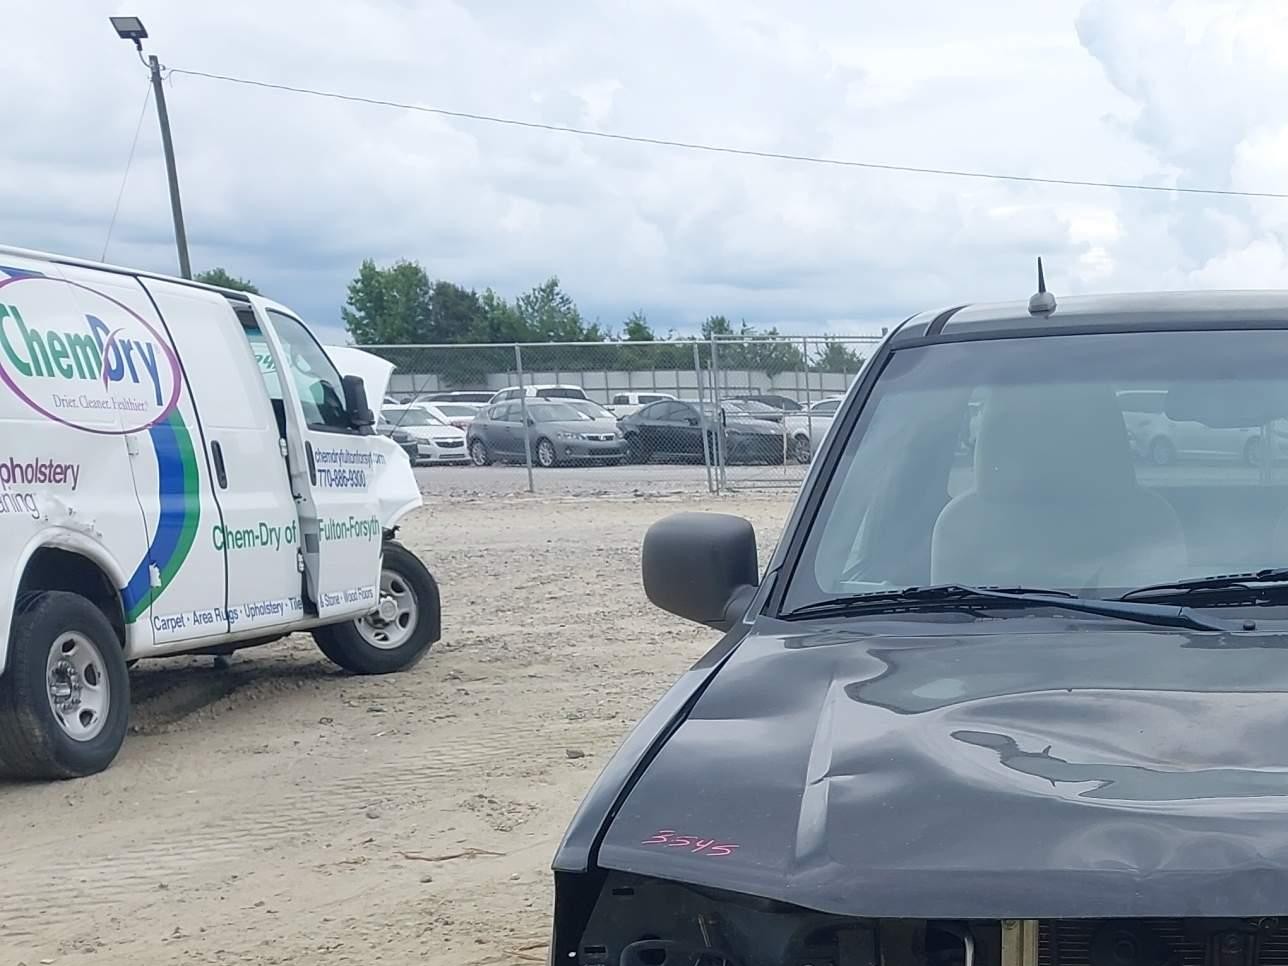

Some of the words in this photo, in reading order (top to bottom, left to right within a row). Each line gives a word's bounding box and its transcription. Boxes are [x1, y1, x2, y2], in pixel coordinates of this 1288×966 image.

[284, 520, 297, 543] of
[153, 613, 186, 632] Carpet
[193, 610, 213, 625] Area
[244, 600, 284, 621] Upholstery
